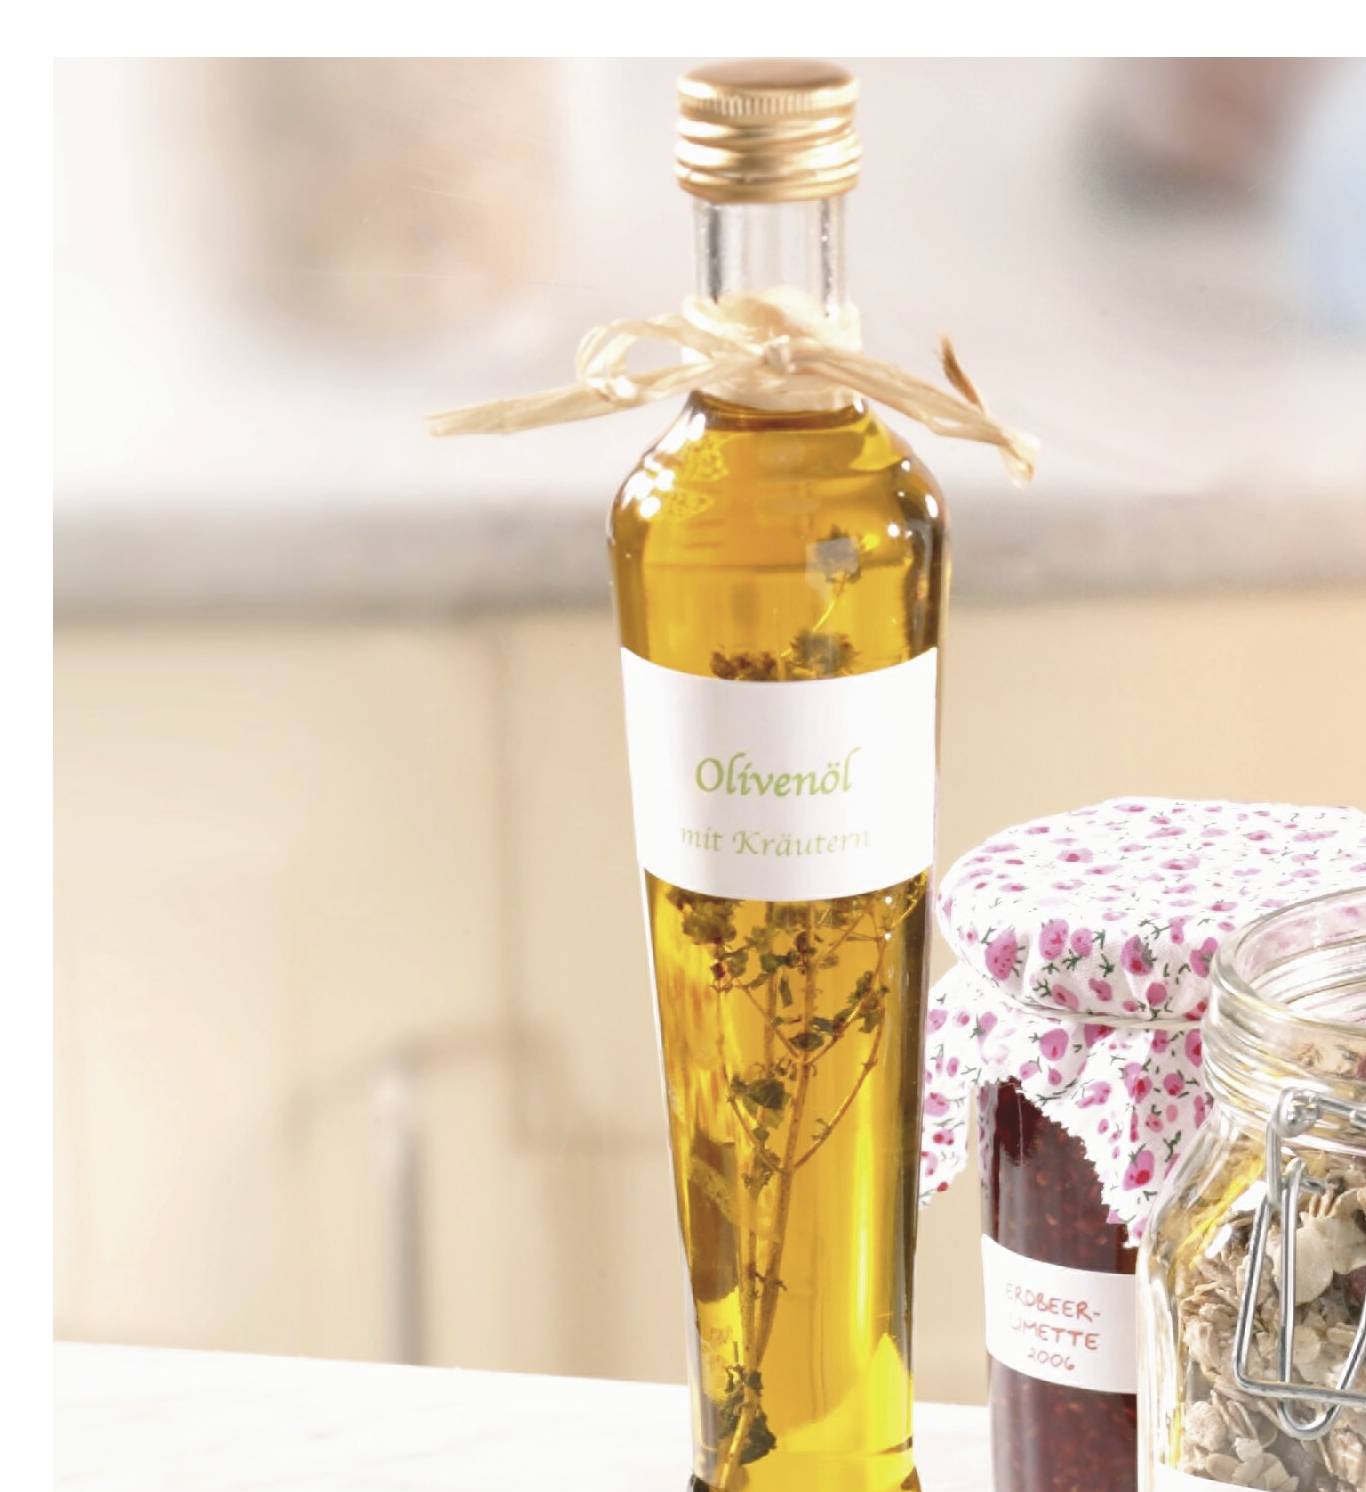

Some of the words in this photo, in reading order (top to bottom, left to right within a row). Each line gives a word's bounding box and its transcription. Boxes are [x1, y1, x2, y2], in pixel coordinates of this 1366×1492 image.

[695, 747, 860, 797] Olivenöl
[682, 826, 722, 852] mit
[733, 829, 870, 857] Kräutern
[1006, 1283, 1100, 1322] ERDBEER-
[1027, 1349, 1075, 1371] 2006
